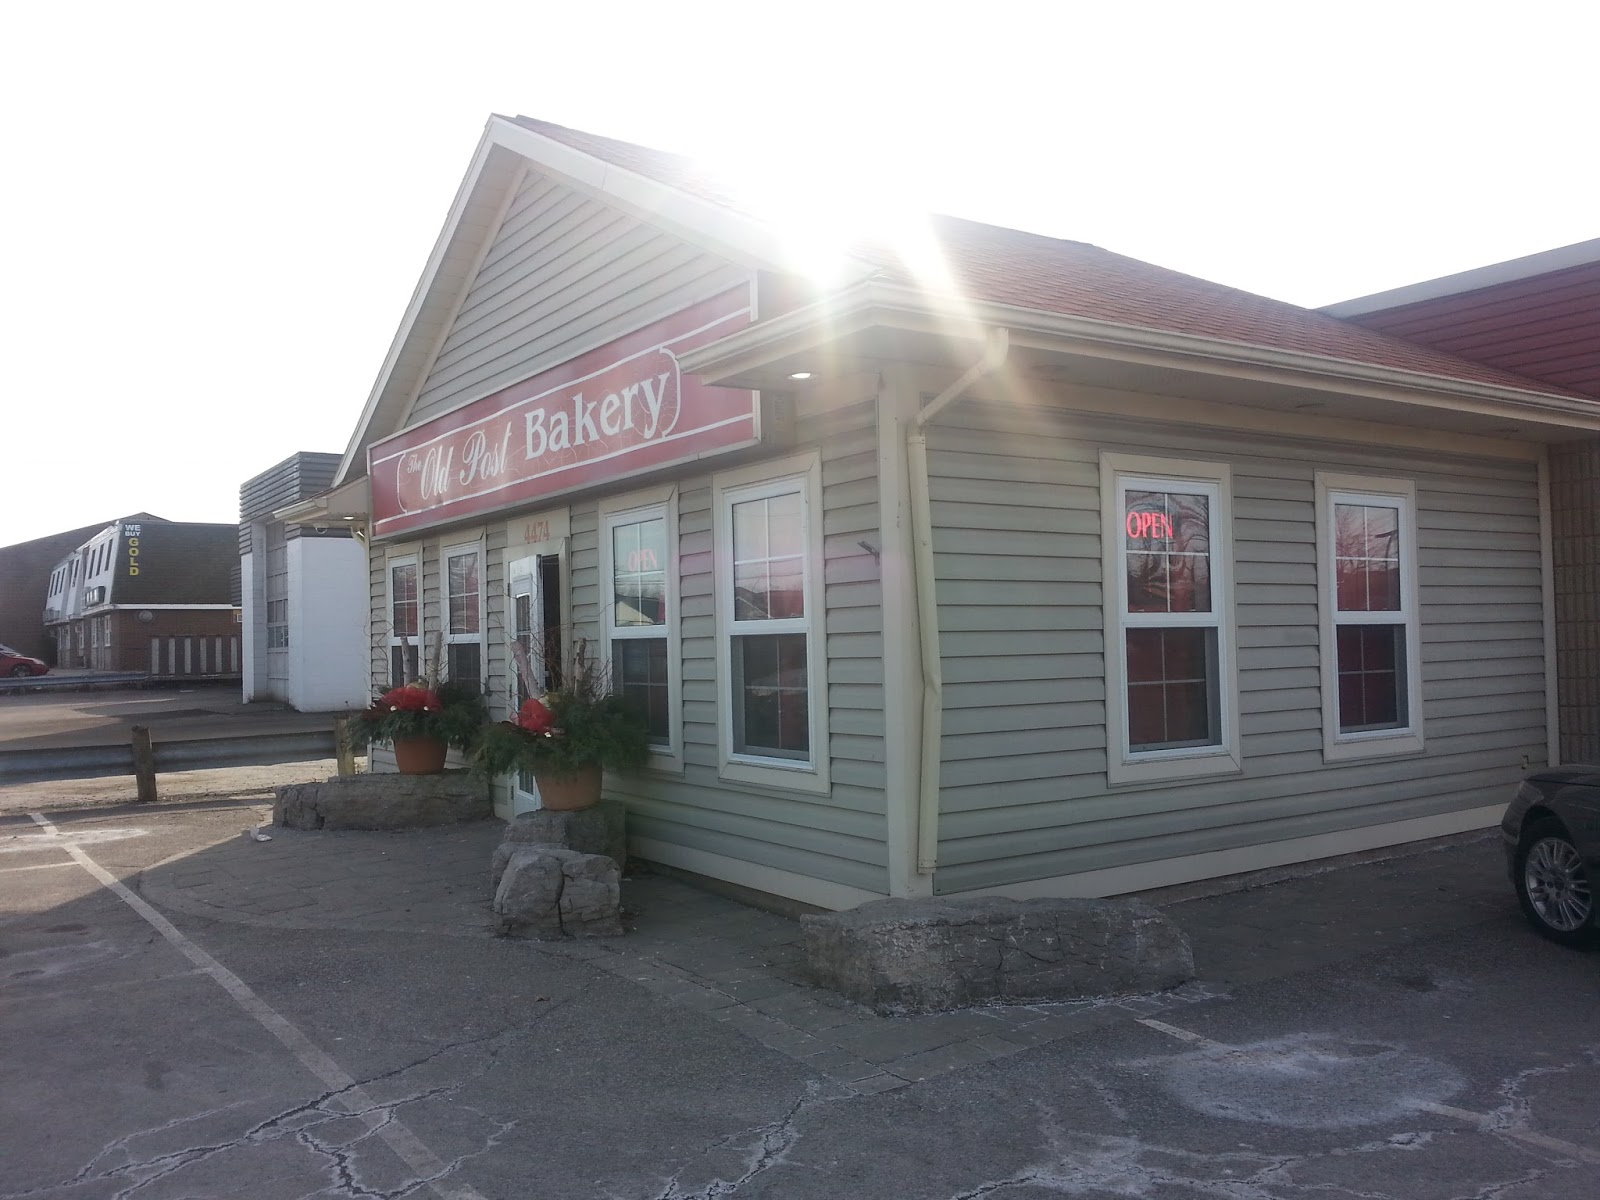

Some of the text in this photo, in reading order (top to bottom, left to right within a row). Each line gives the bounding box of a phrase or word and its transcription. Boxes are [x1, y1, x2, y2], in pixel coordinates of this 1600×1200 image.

[407, 372, 670, 500] The Old Post Bakery
[524, 520, 550, 544] 4474
[1126, 512, 1173, 539] OPEN
[128, 537, 139, 576] GOLD
[627, 548, 657, 572] OPEN
